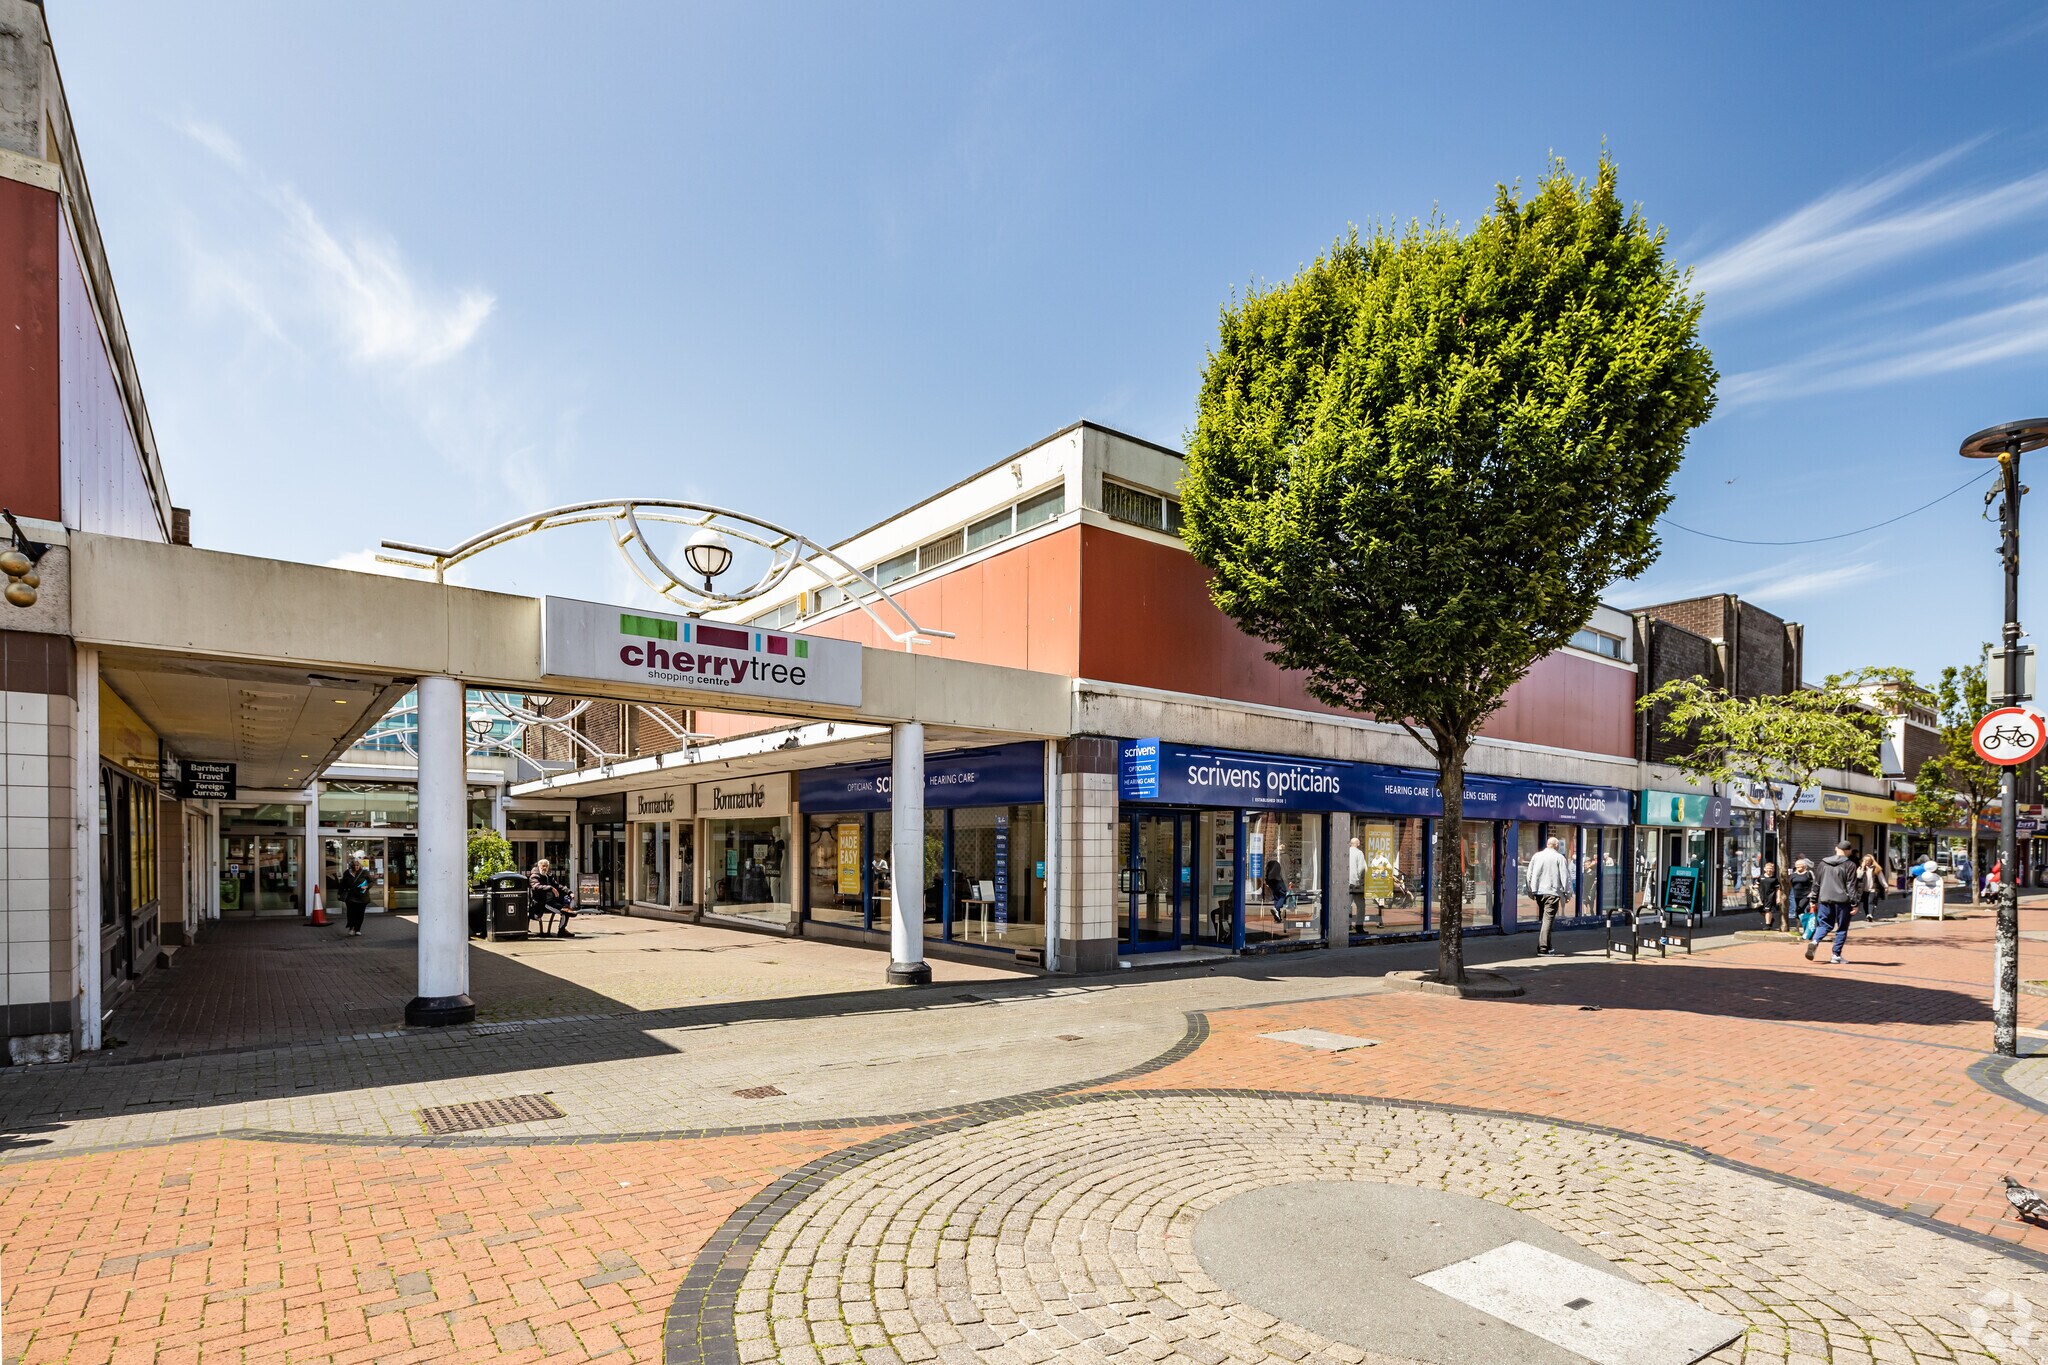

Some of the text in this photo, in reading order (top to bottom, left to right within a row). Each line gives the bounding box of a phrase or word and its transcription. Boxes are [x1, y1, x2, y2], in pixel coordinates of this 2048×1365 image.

[648, 670, 730, 686] shopping centre
[1124, 745, 1156, 758] scrivens
[191, 764, 229, 772] Barrhead
[1128, 764, 1152, 772] OPTICIANS
[198, 772, 223, 780] Travel
[929, 774, 957, 785] HEARING
[958, 772, 975, 783] CARE
[1124, 778, 1143, 786] HEARING
[1188, 760, 1340, 796] scrivens opticians
[196, 783, 224, 791] Foreign
[847, 781, 873, 792] OPTICIANS
[1384, 785, 1413, 796] HEARING
[1413, 787, 1429, 797] CARE
[192, 790, 227, 798] Currency
[712, 782, 766, 811] Bonmarché
[1463, 791, 1497, 802] LENS CENTRE
[637, 792, 675, 815] Bonmarché
[1527, 789, 1606, 814] scrivens opticians
[1715, 808, 1721, 818] BT
[840, 836, 857, 849] MADE
[1368, 837, 1390, 851] MADE
[840, 850, 858, 865] EASY
